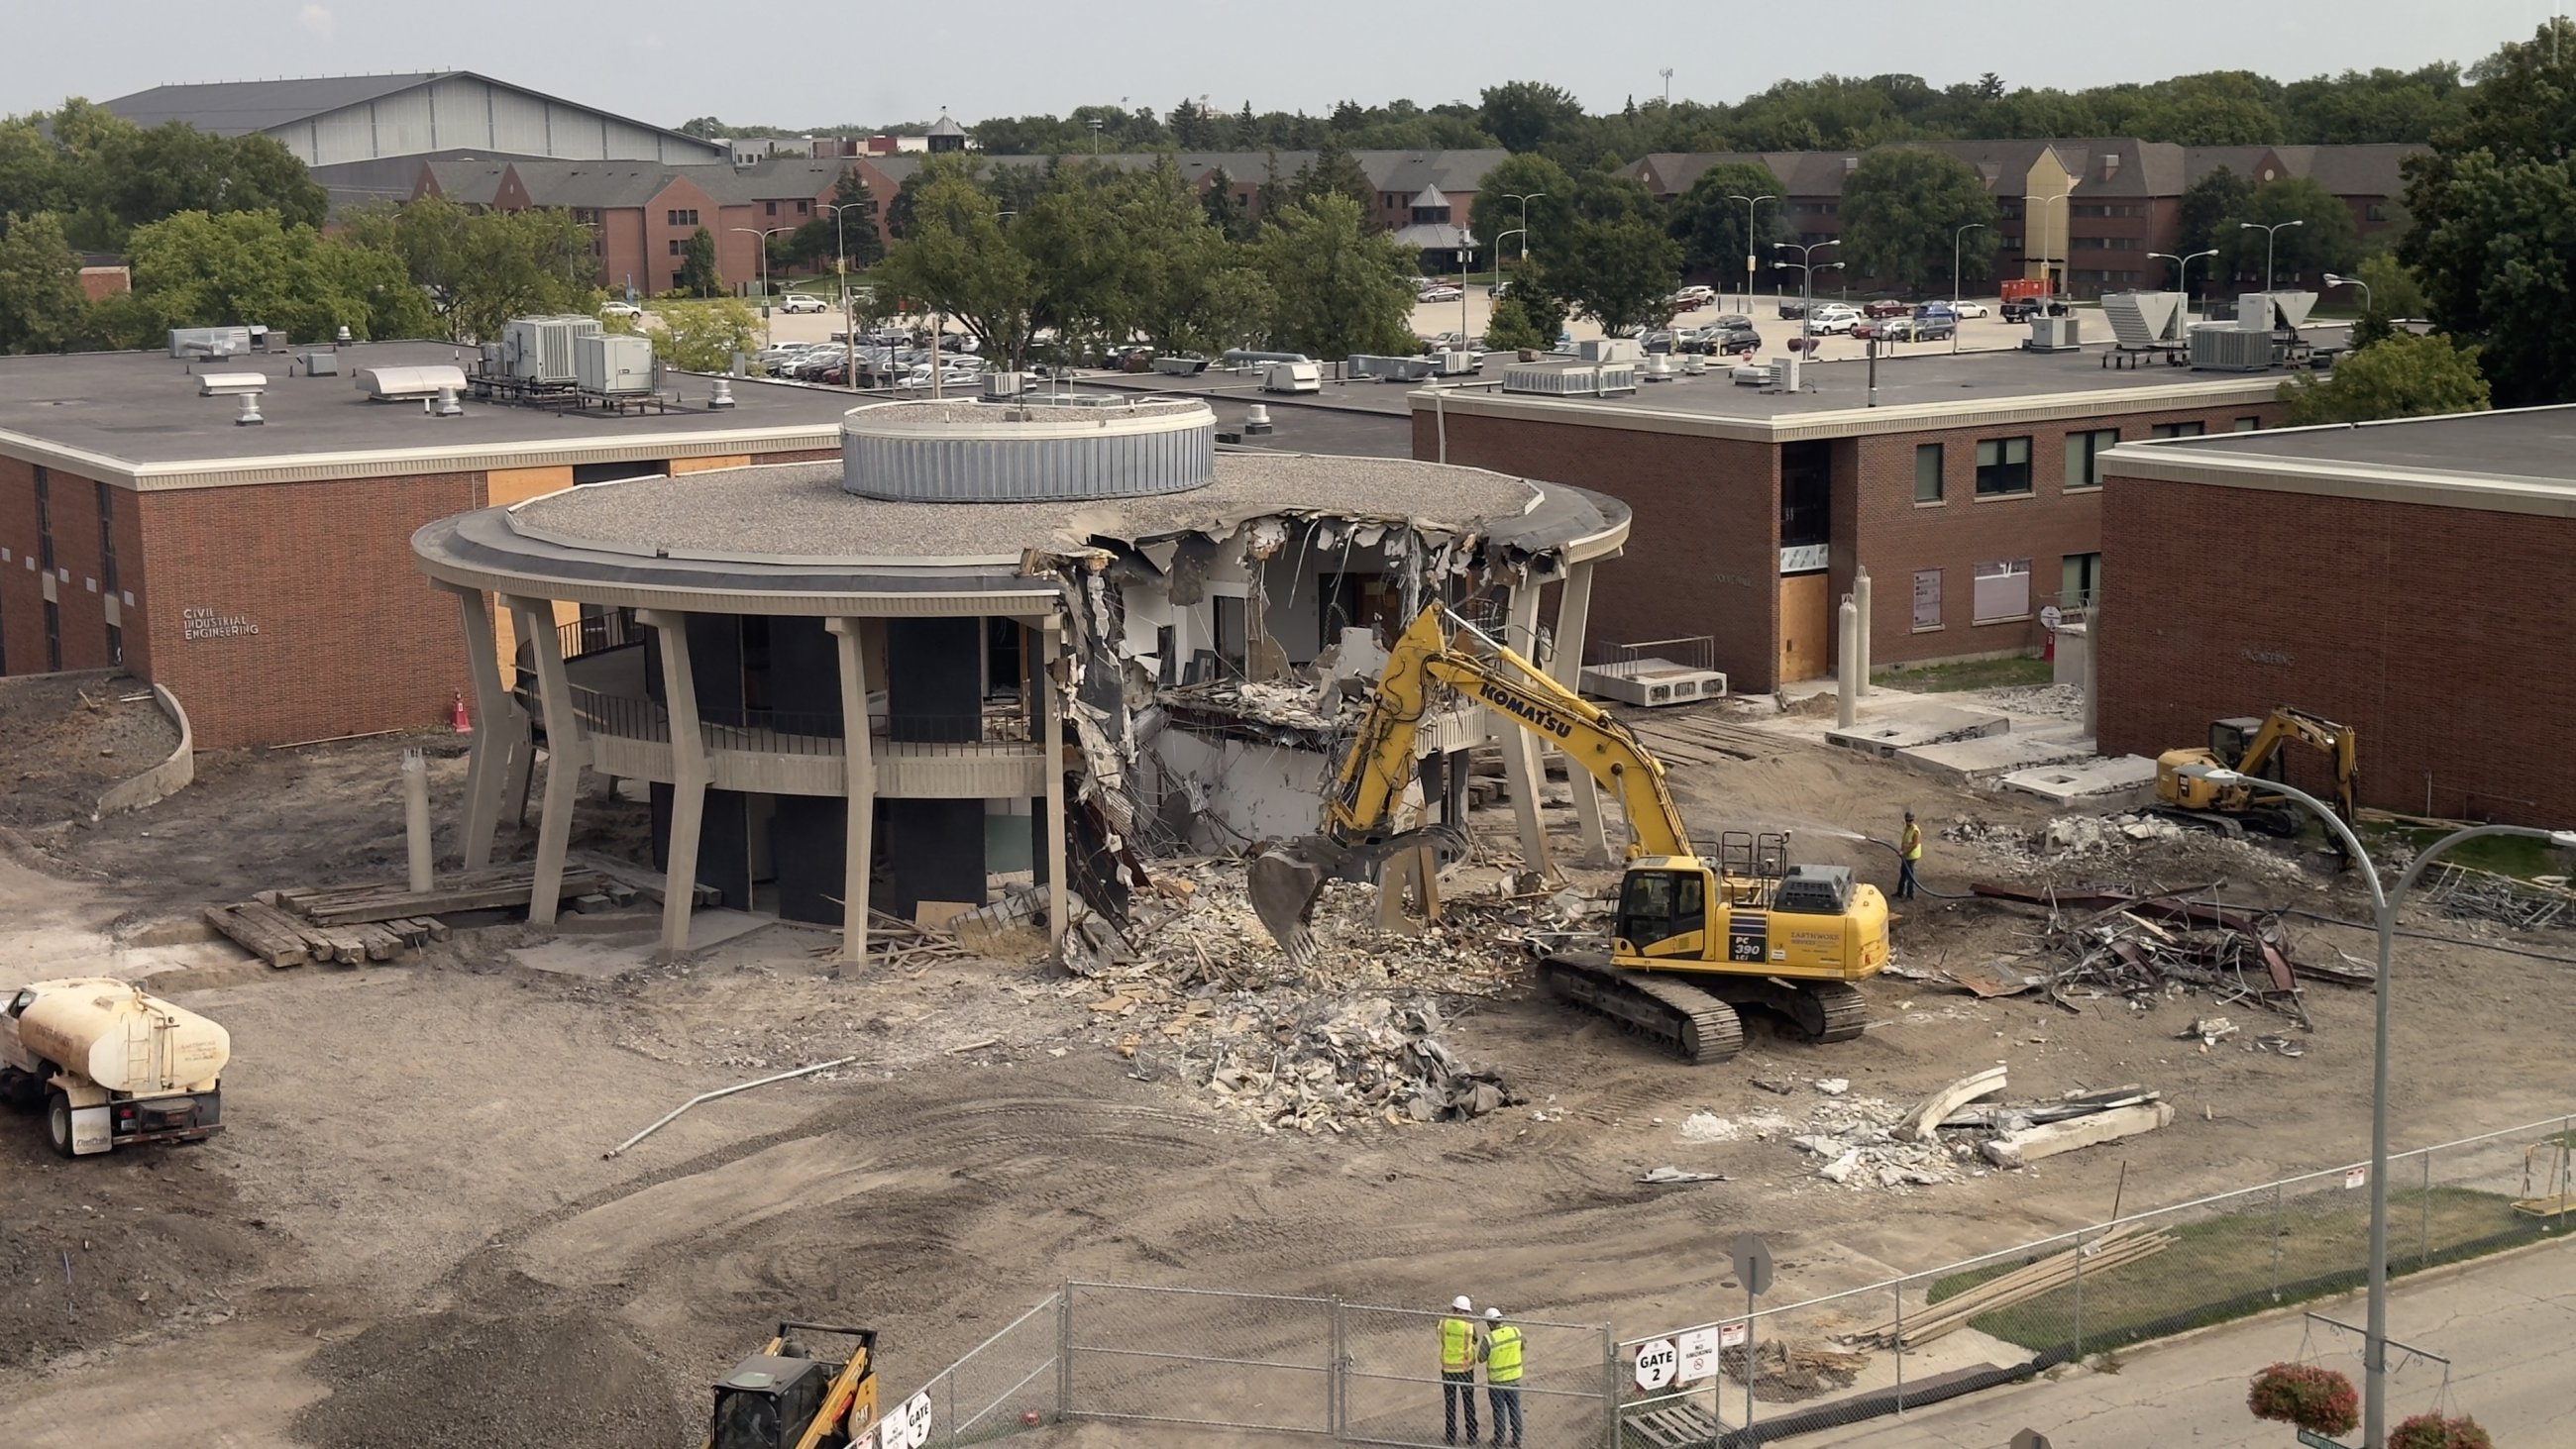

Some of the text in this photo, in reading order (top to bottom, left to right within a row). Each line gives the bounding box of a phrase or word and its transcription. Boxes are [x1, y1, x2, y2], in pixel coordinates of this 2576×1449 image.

[183, 608, 214, 619] CIVIL
[184, 616, 247, 629] INDUSTRIAL
[185, 625, 259, 640] ENGINEERING
[1479, 681, 1571, 738] KOMATSU
[1735, 936, 1750, 945] PC
[1735, 944, 1761, 955] 390
[1640, 1351, 1672, 1368] GATE
[1685, 1348, 1712, 1359] SMOKING
[1652, 1369, 1661, 1381] 2
[855, 1404, 869, 1427] CAT
[910, 1402, 928, 1426] GATE
[917, 1424, 922, 1438] 2
